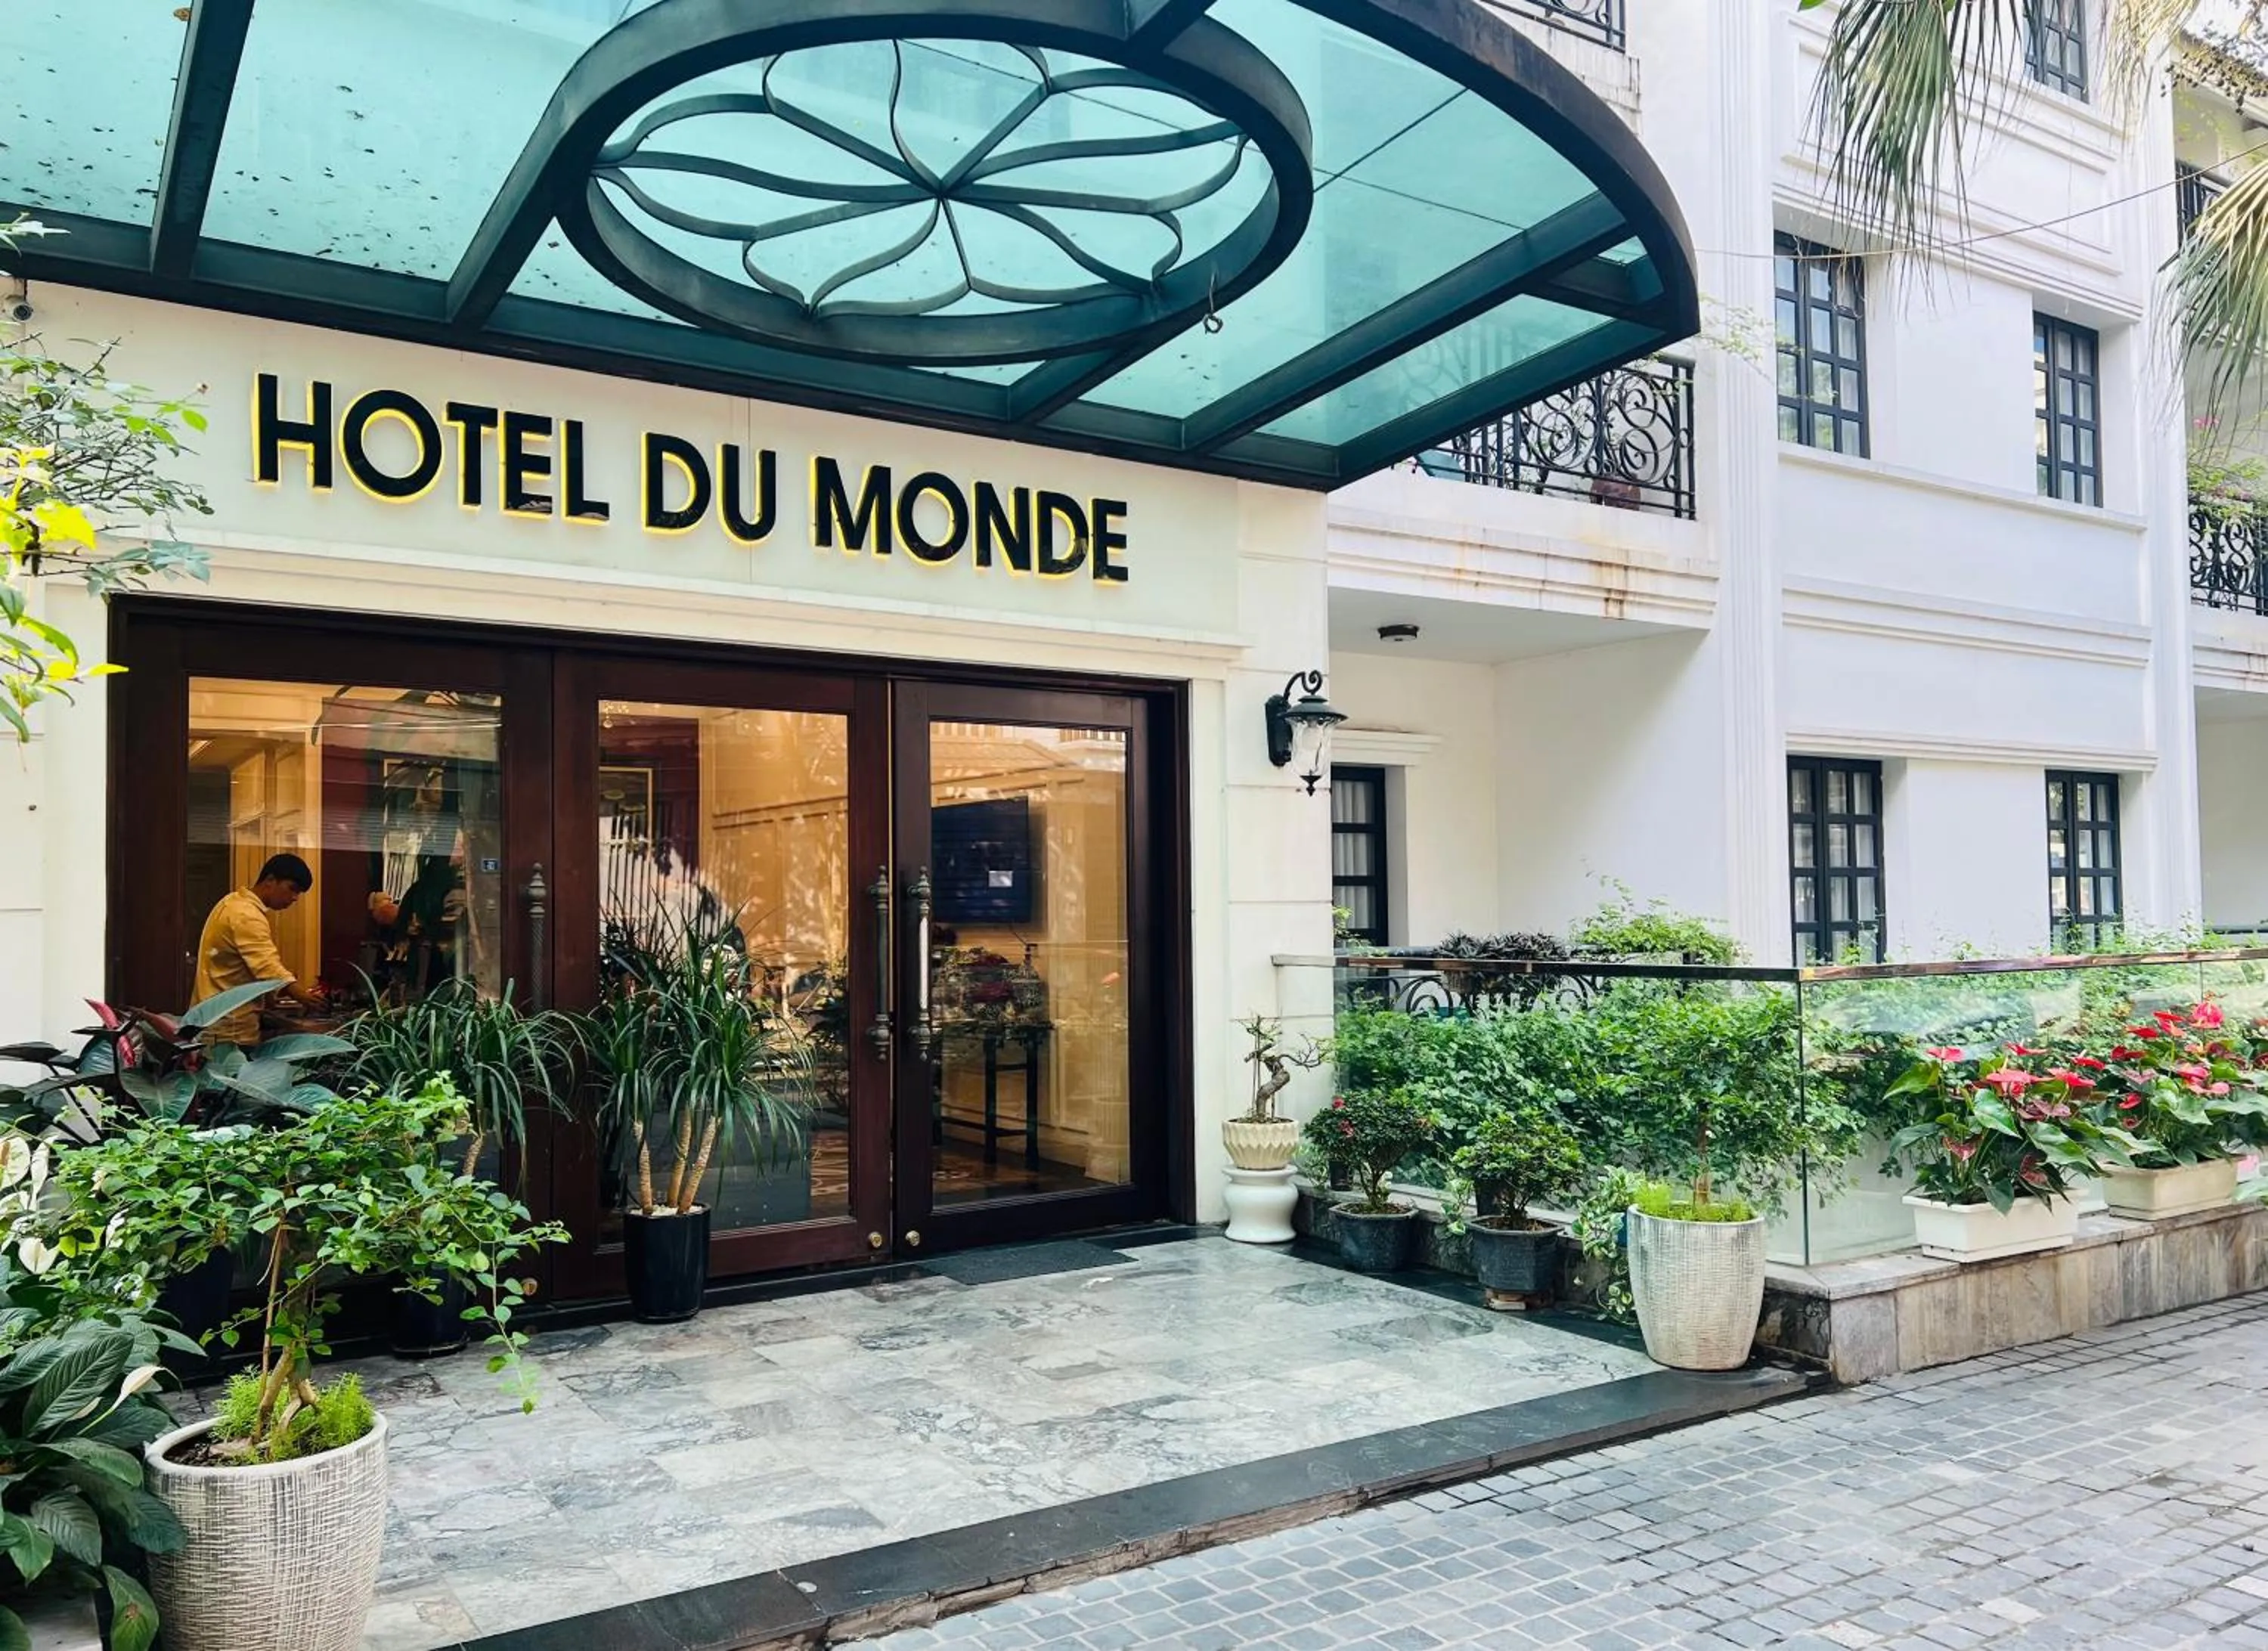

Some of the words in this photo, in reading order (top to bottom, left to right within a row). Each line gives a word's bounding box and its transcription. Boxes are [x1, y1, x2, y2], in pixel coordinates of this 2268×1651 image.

[253, 373, 610, 523] HOTEL
[643, 432, 776, 544] DU
[812, 455, 1129, 584] MONDE
